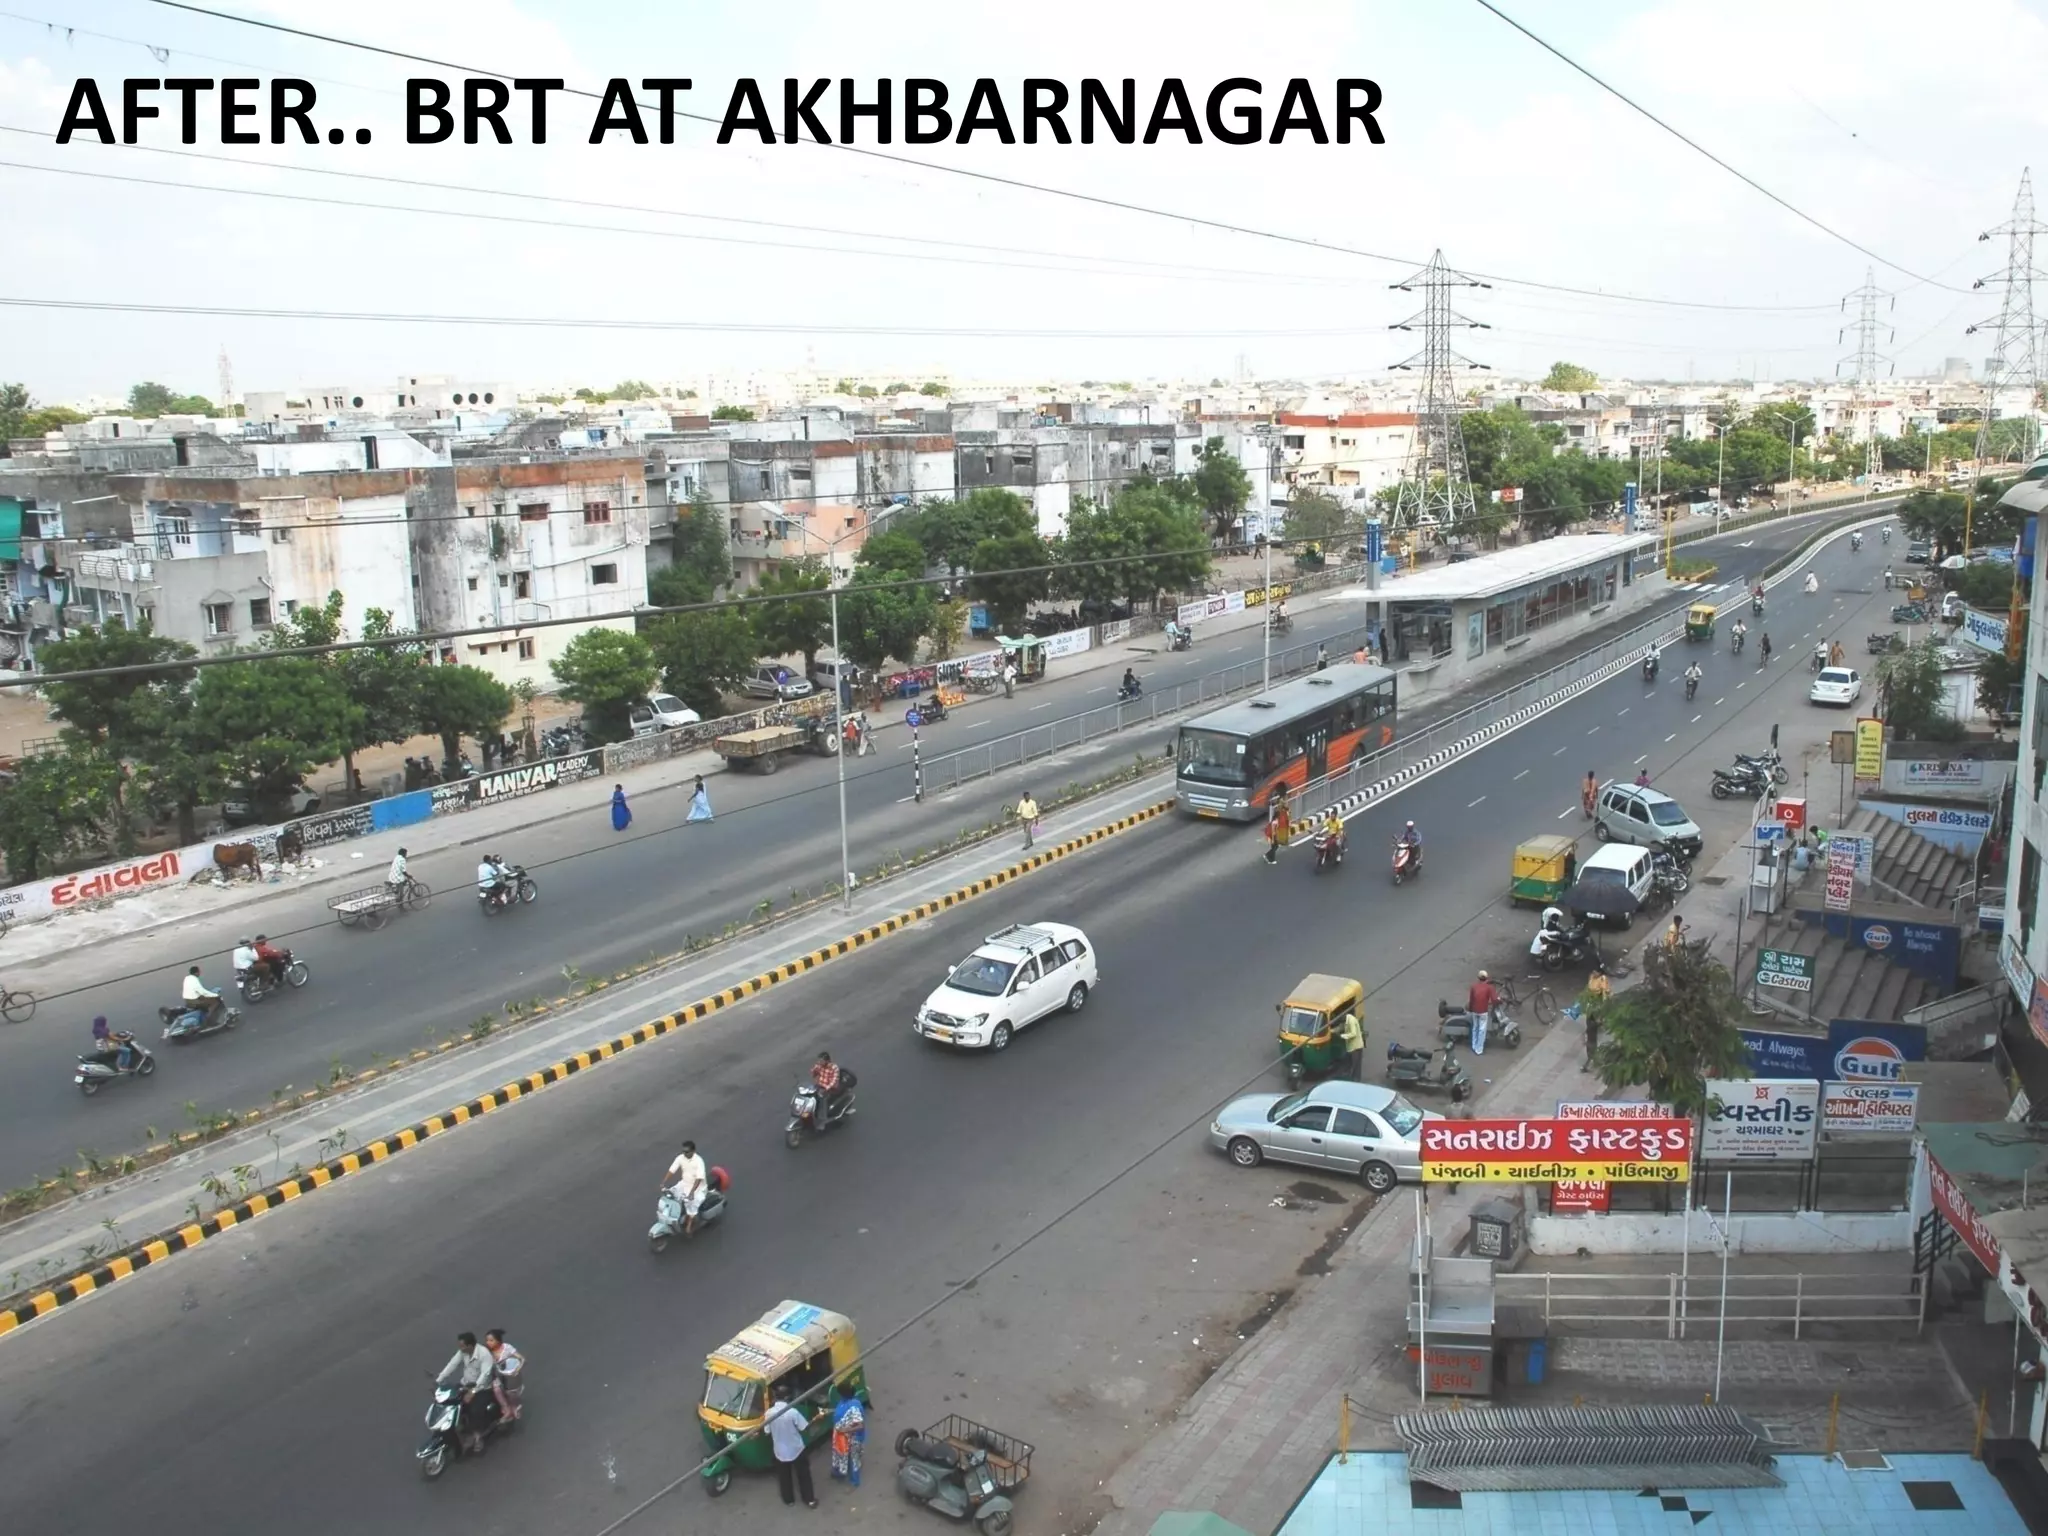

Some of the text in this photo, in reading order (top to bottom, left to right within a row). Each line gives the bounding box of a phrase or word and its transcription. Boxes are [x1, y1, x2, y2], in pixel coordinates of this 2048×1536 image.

[1918, 763, 1963, 772] KRISNA
[480, 763, 558, 798] MANIYAR
[556, 756, 589, 773] ACADEMY
[51, 851, 180, 905] દંતાવલી
[1865, 932, 1891, 942] Gulf
[1780, 955, 1805, 967] રામ
[1771, 974, 1809, 990] Castrol
[1840, 1056, 1903, 1079] Gulf
[1425, 1122, 1553, 1152] સનરાઈઝ
[1431, 1162, 1487, 1179] પંજાબી
[1508, 1162, 1578, 1179] ચાઈનીઝ
